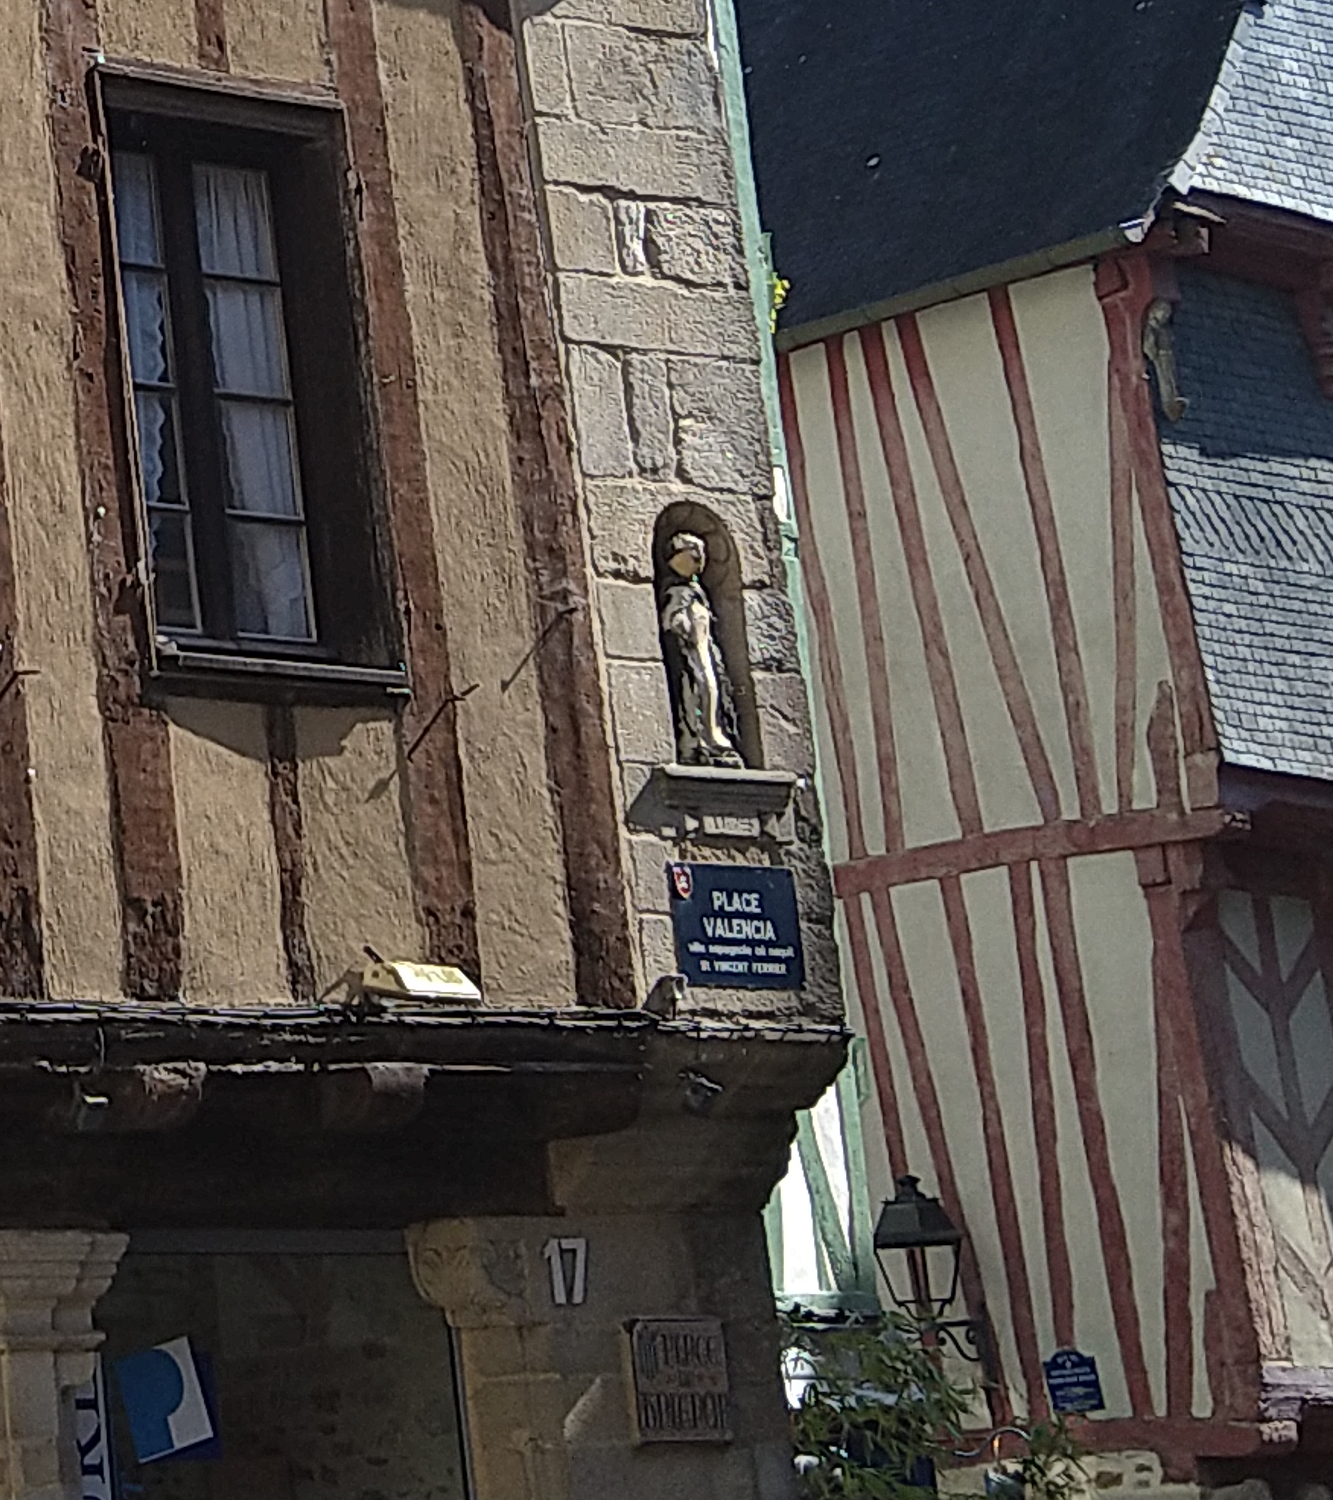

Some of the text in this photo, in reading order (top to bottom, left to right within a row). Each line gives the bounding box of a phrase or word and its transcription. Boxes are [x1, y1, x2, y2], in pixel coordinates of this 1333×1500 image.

[712, 890, 762, 913] PLACE
[702, 916, 777, 941] VALENCIA
[543, 1237, 587, 1305] 17
